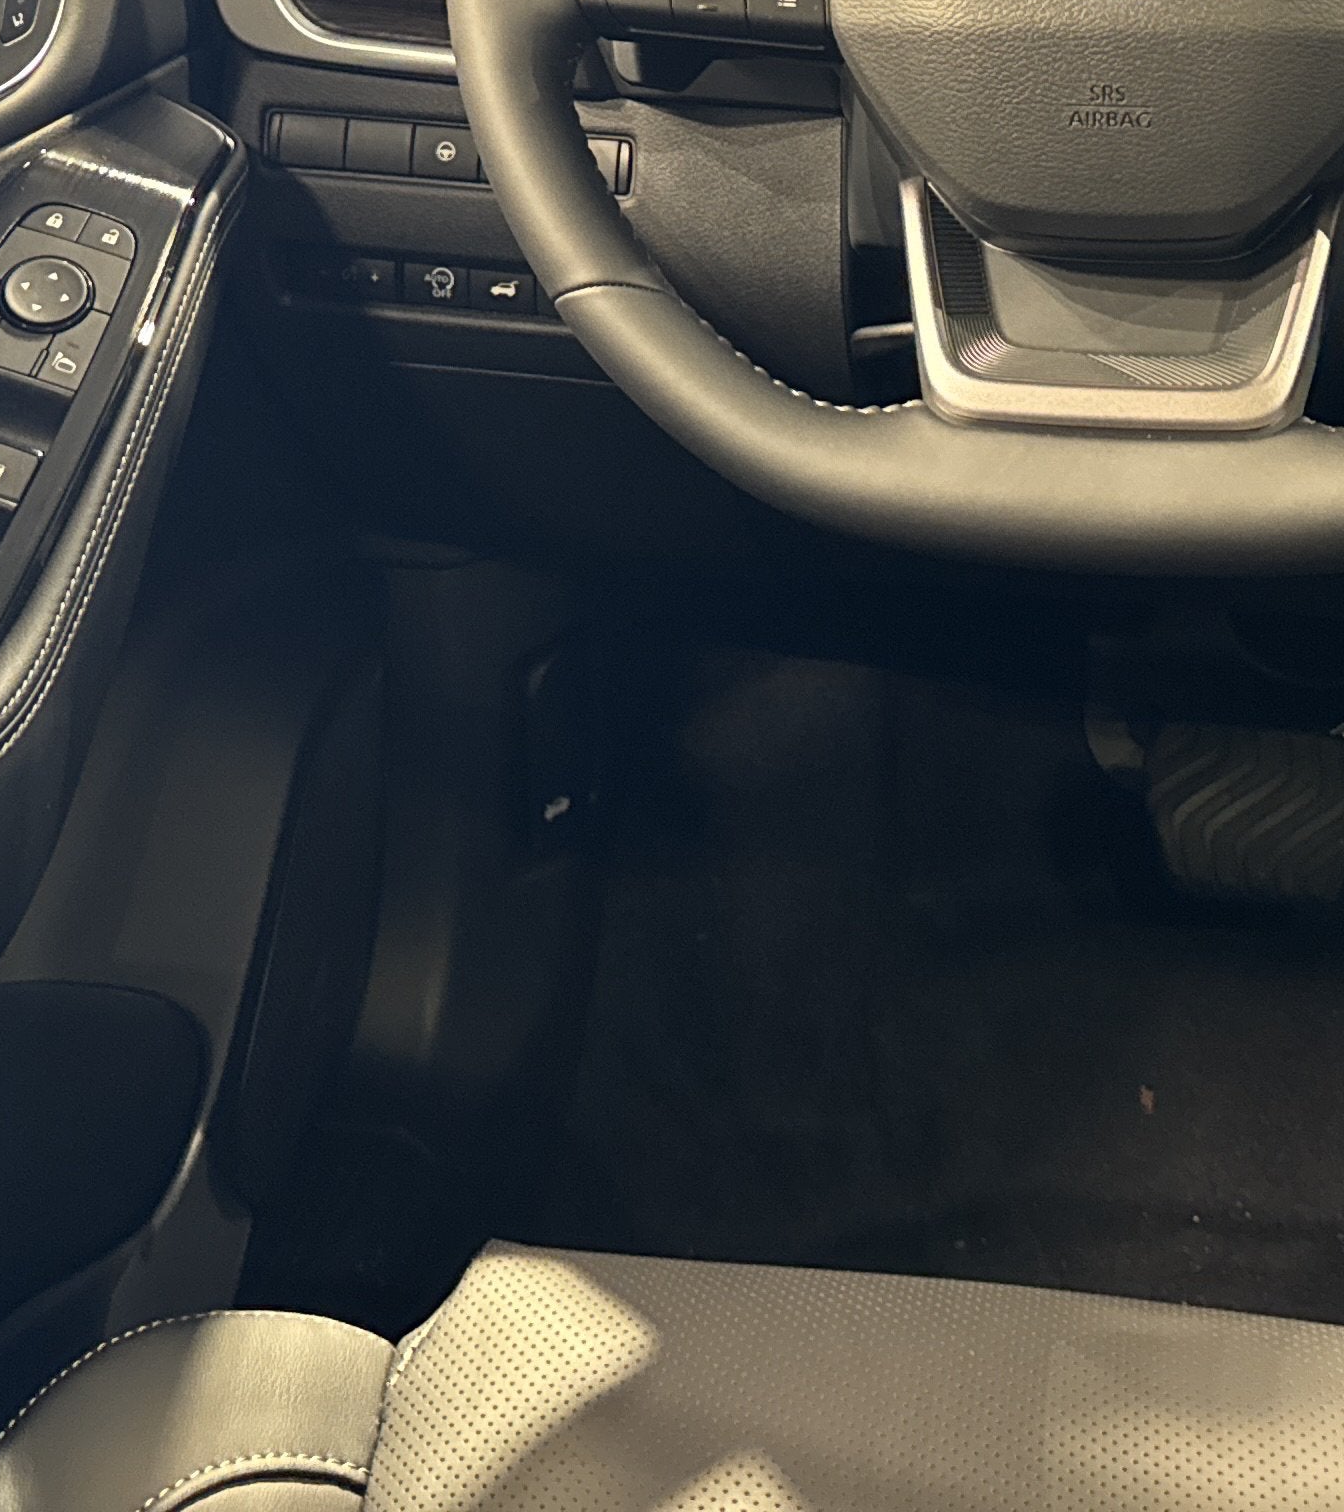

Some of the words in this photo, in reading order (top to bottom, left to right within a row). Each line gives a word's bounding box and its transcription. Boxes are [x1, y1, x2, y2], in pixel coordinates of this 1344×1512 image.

[1088, 84, 1128, 102] SRS
[1068, 110, 1153, 129] AIRBAG
[423, 273, 449, 284] AUTO
[431, 288, 452, 299] OFF
